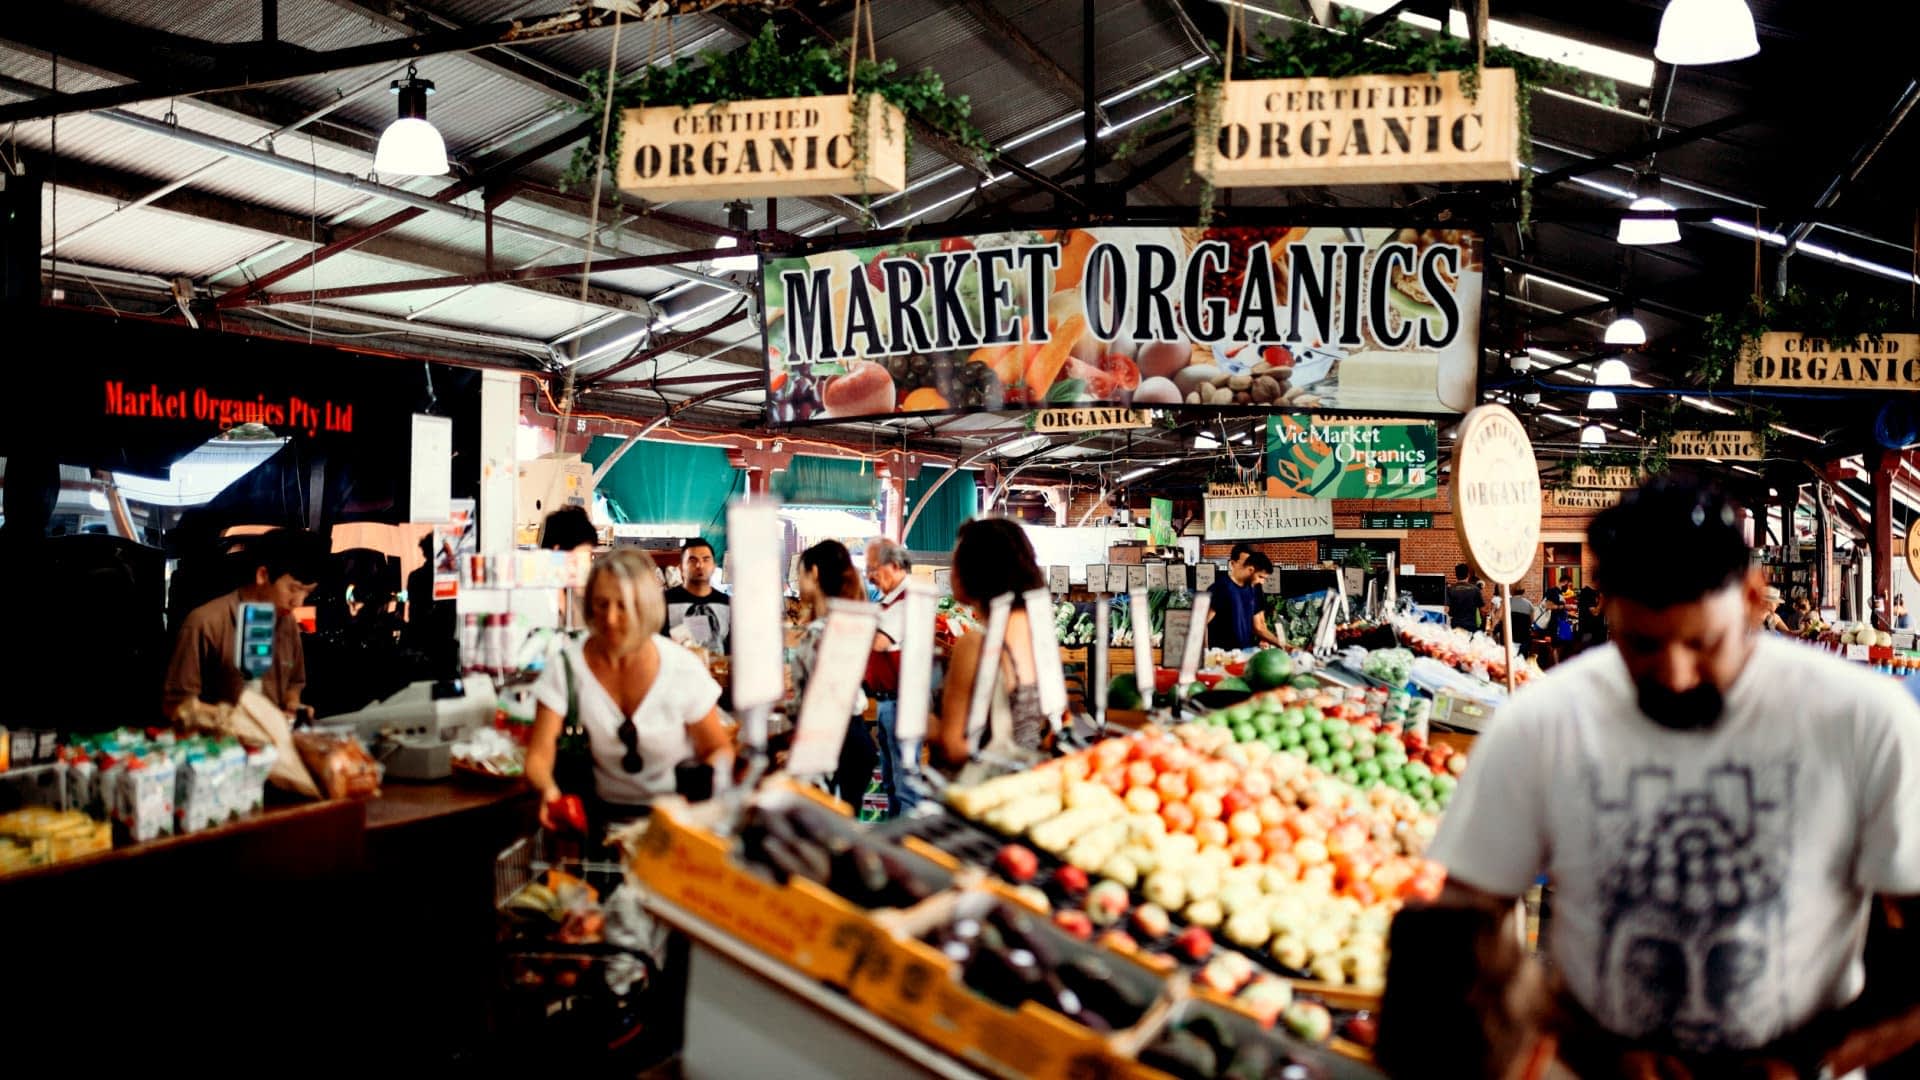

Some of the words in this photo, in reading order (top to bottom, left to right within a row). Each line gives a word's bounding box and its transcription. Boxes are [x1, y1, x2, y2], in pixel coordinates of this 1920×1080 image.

[1264, 85, 1443, 113] CERTIFIED
[673, 109, 820, 136] CERTIFIED
[1217, 113, 1483, 160] ORGANIC
[634, 134, 856, 179] ORGANIC
[782, 244, 1060, 364] MARKET
[1084, 241, 1460, 349] ORGANICS
[1753, 356, 1920, 382] ORGANIC
[105, 380, 187, 418] Market
[193, 387, 285, 430] Organics
[289, 396, 320, 437] Pty
[325, 400, 353, 432] Ltd
[1042, 408, 1136, 428] ORGANIC
[1275, 424, 1381, 444] VicMarket
[1335, 443, 1426, 468] Organics
[1667, 442, 1754, 457] ORGANIC
[1577, 475, 1639, 487] ORGANI
[1212, 488, 1256, 497] ORGANIC
[1558, 498, 1615, 508] ORGANIC
[1235, 507, 1280, 520] FRESH
[1235, 515, 1329, 531] GENERATION
